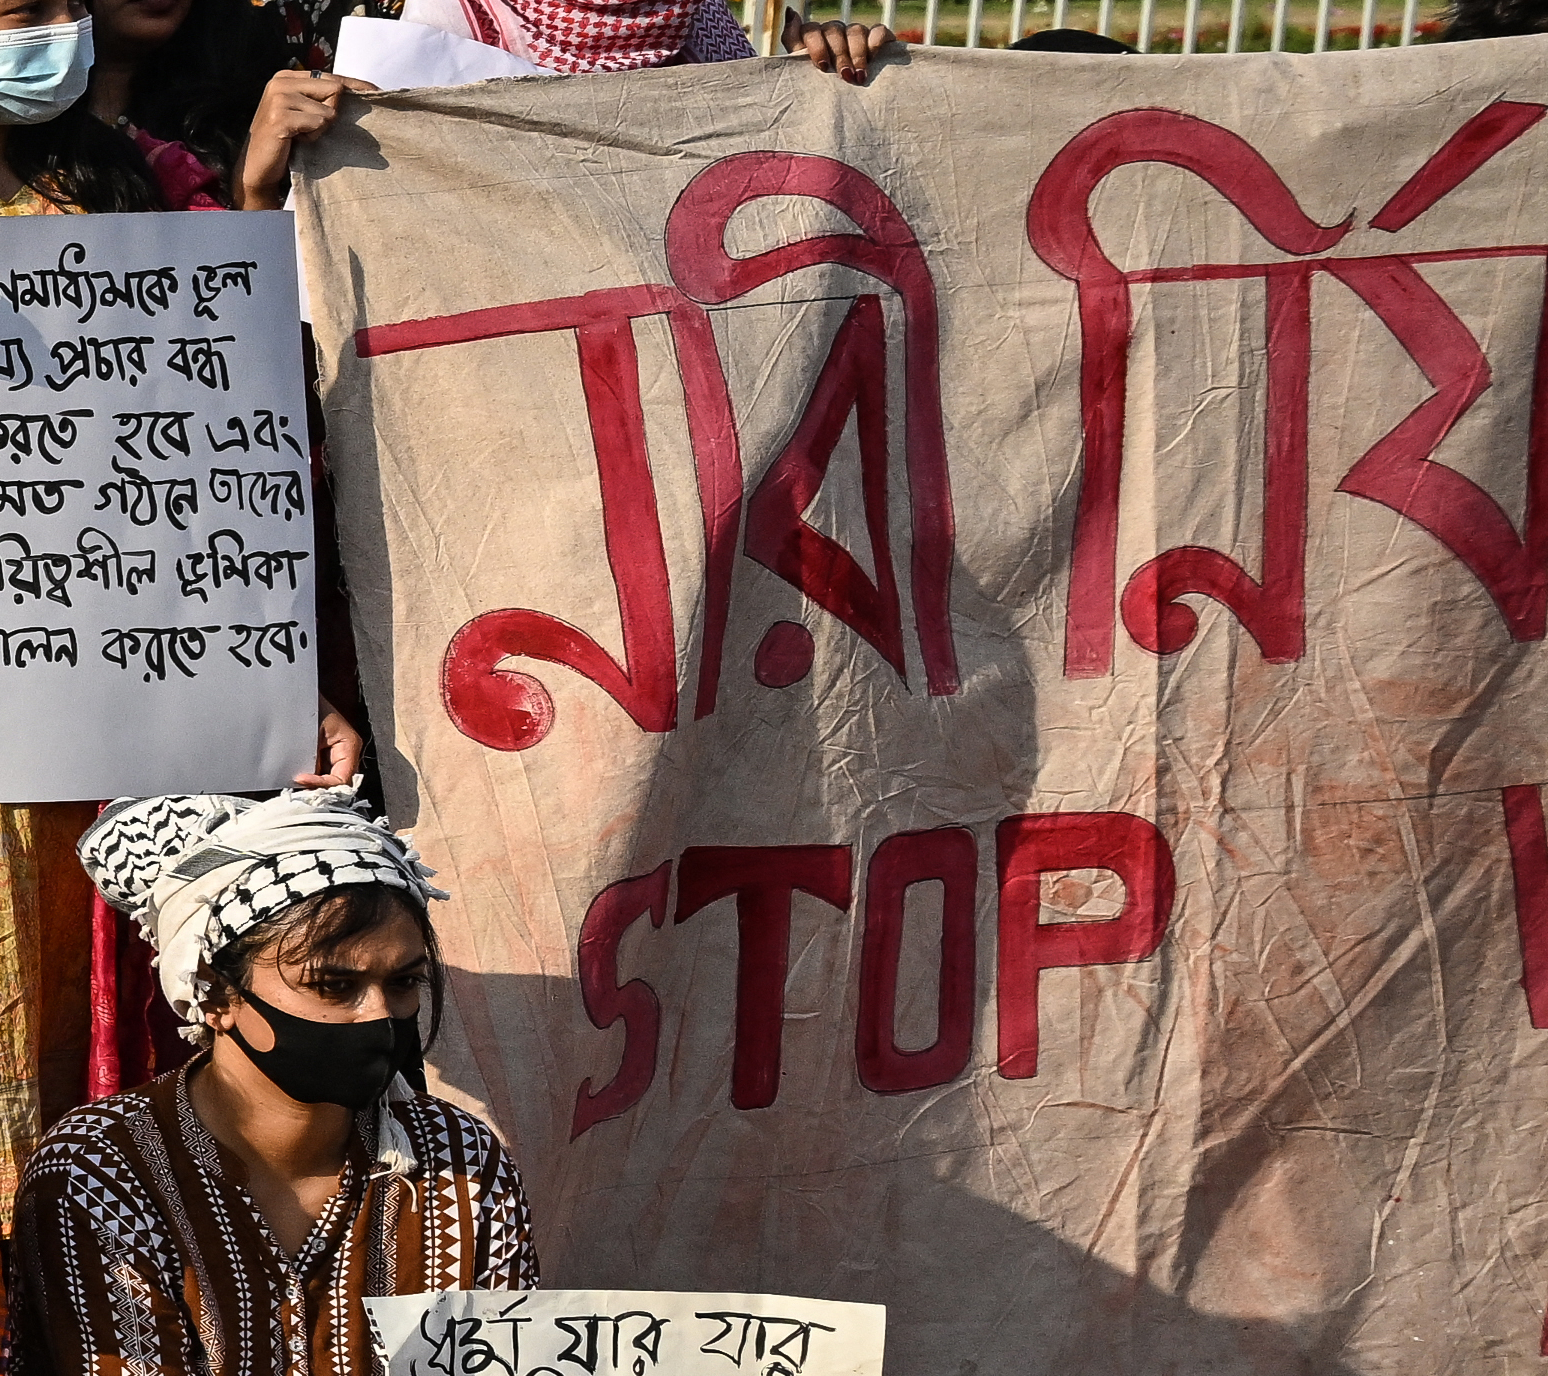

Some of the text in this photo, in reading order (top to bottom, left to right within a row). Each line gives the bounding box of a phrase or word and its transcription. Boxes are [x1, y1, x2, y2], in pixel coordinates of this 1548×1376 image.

[191, 260, 259, 321] ভূল
[43, 335, 155, 393] প্রচার
[167, 334, 237, 392] বন্ধ
[112, 410, 196, 462] হবে
[205, 409, 305, 460] এবং
[354, 106, 1548, 754] নারী নির্য
[93, 455, 200, 531] গঠনে
[208, 467, 307, 522] তাদের
[175, 529, 311, 604] ভূমিকা
[100, 624, 222, 684] করতে
[569, 810, 1178, 1142] STOP
[554, 1311, 671, 1376] যার
